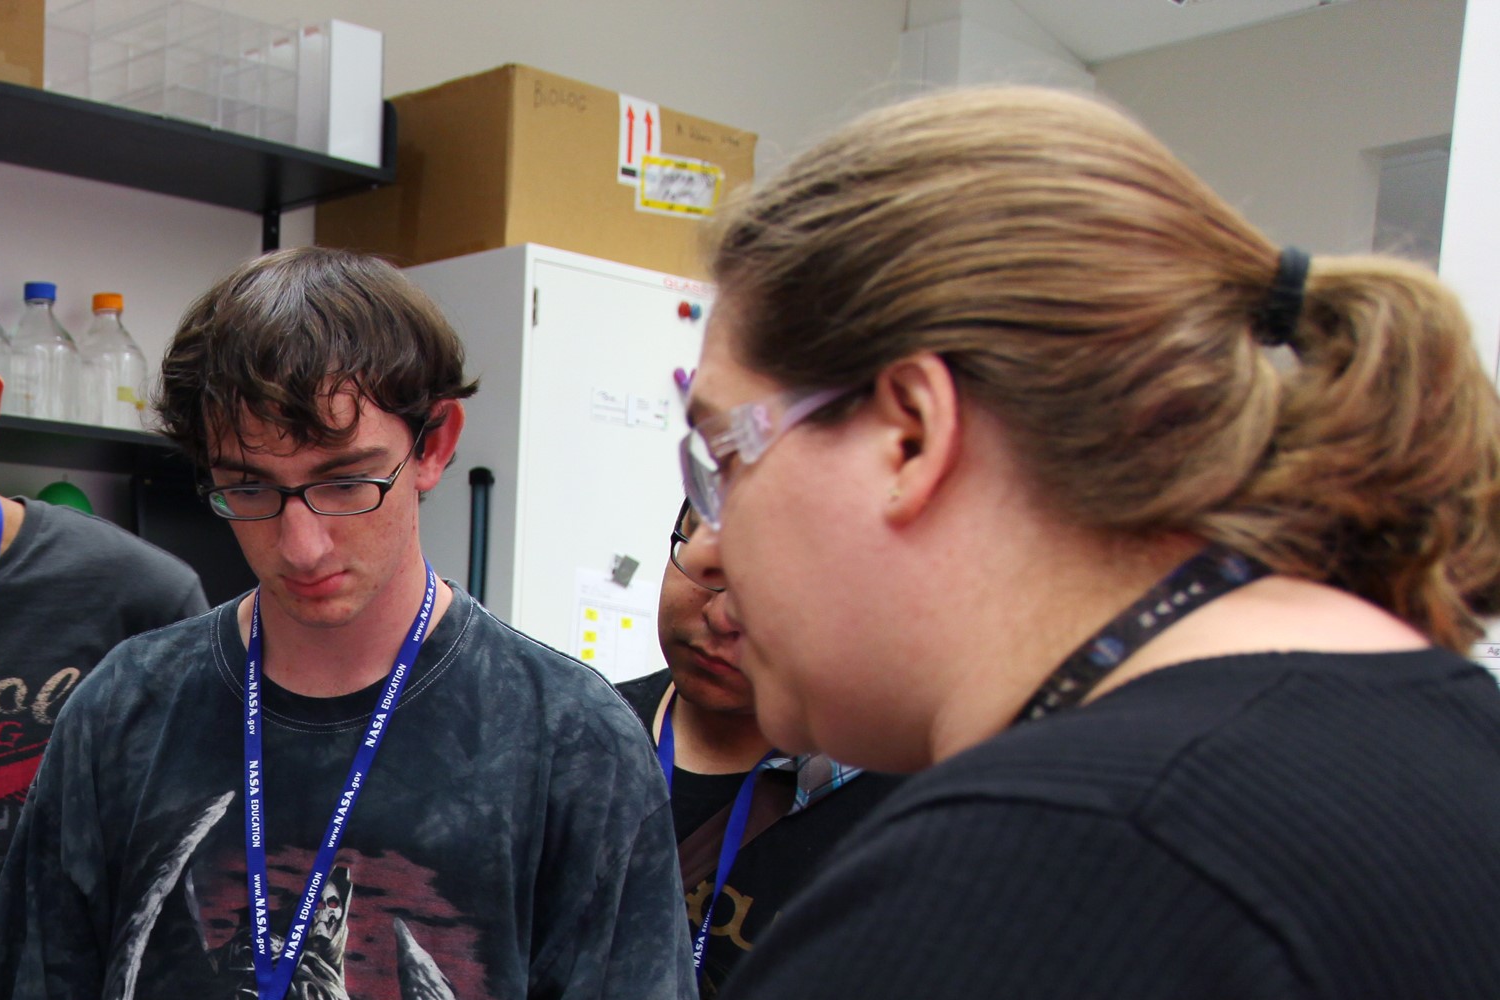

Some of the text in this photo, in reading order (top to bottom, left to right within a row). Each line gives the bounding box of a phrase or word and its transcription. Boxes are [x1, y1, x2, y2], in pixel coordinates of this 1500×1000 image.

[247, 660, 258, 735] www.NASA.gov
[365, 663, 407, 748] NASA EDUCATION
[249, 760, 261, 848] NASA EDUCATION
[328, 770, 363, 848] www.NASA.gov
[253, 874, 267, 954] www.NASA.gov
[284, 872, 323, 959] NASA EDUCATION
[694, 936, 705, 968] NASA
